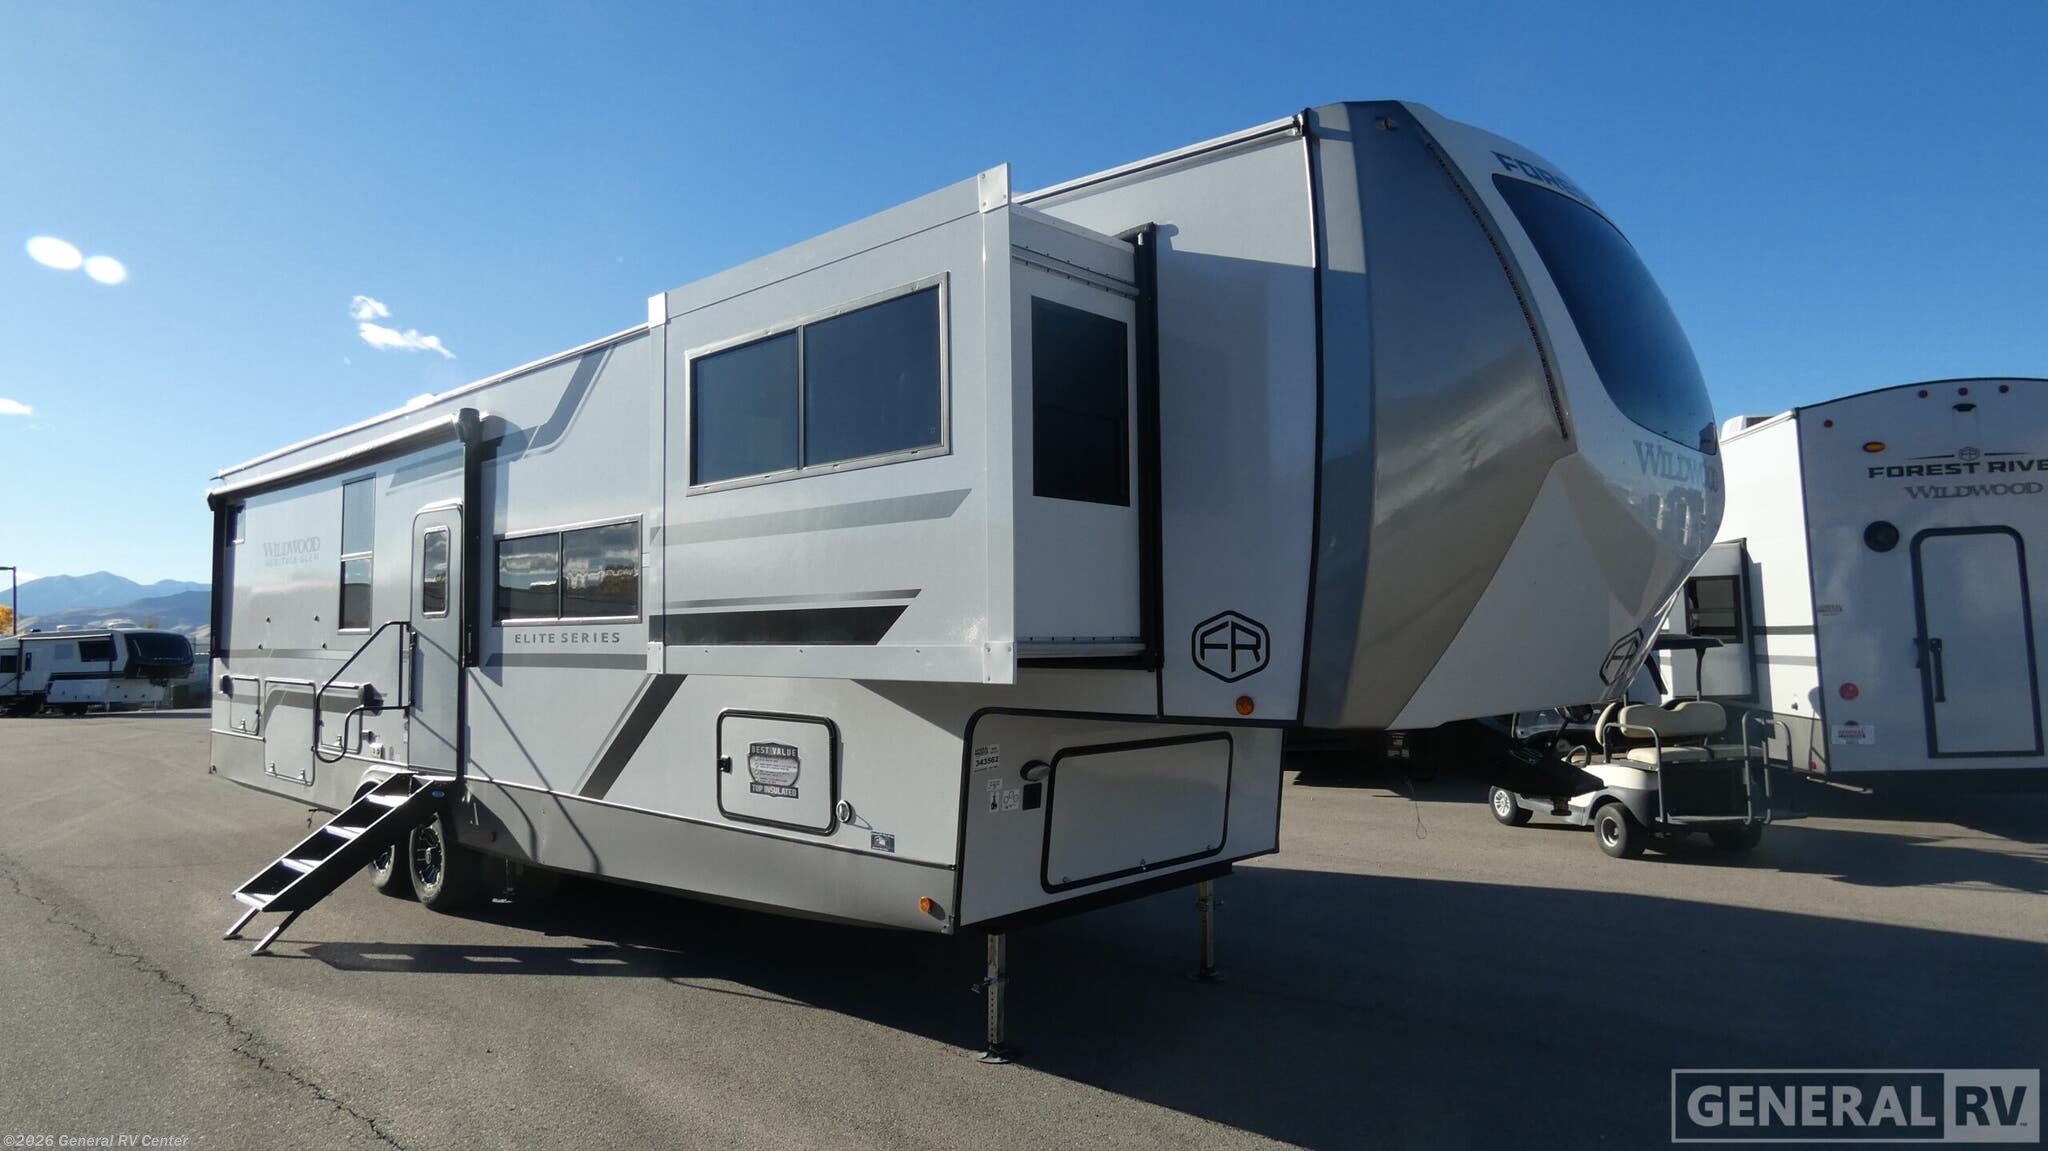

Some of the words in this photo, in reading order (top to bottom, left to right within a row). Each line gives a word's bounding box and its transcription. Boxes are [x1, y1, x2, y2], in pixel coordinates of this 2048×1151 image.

[1868, 462, 1980, 478] FOREST
[1988, 459, 2048, 473] RIVE
[1904, 482, 2044, 499] WILDWOOD
[263, 536, 320, 557] WILDWOOD
[514, 633, 556, 644] ELITE
[560, 632, 621, 644] SERIES
[751, 745, 769, 754] BEST
[772, 746, 796, 757] VALUE
[751, 783, 763, 793] TOP
[763, 785, 797, 797] INSULATED
